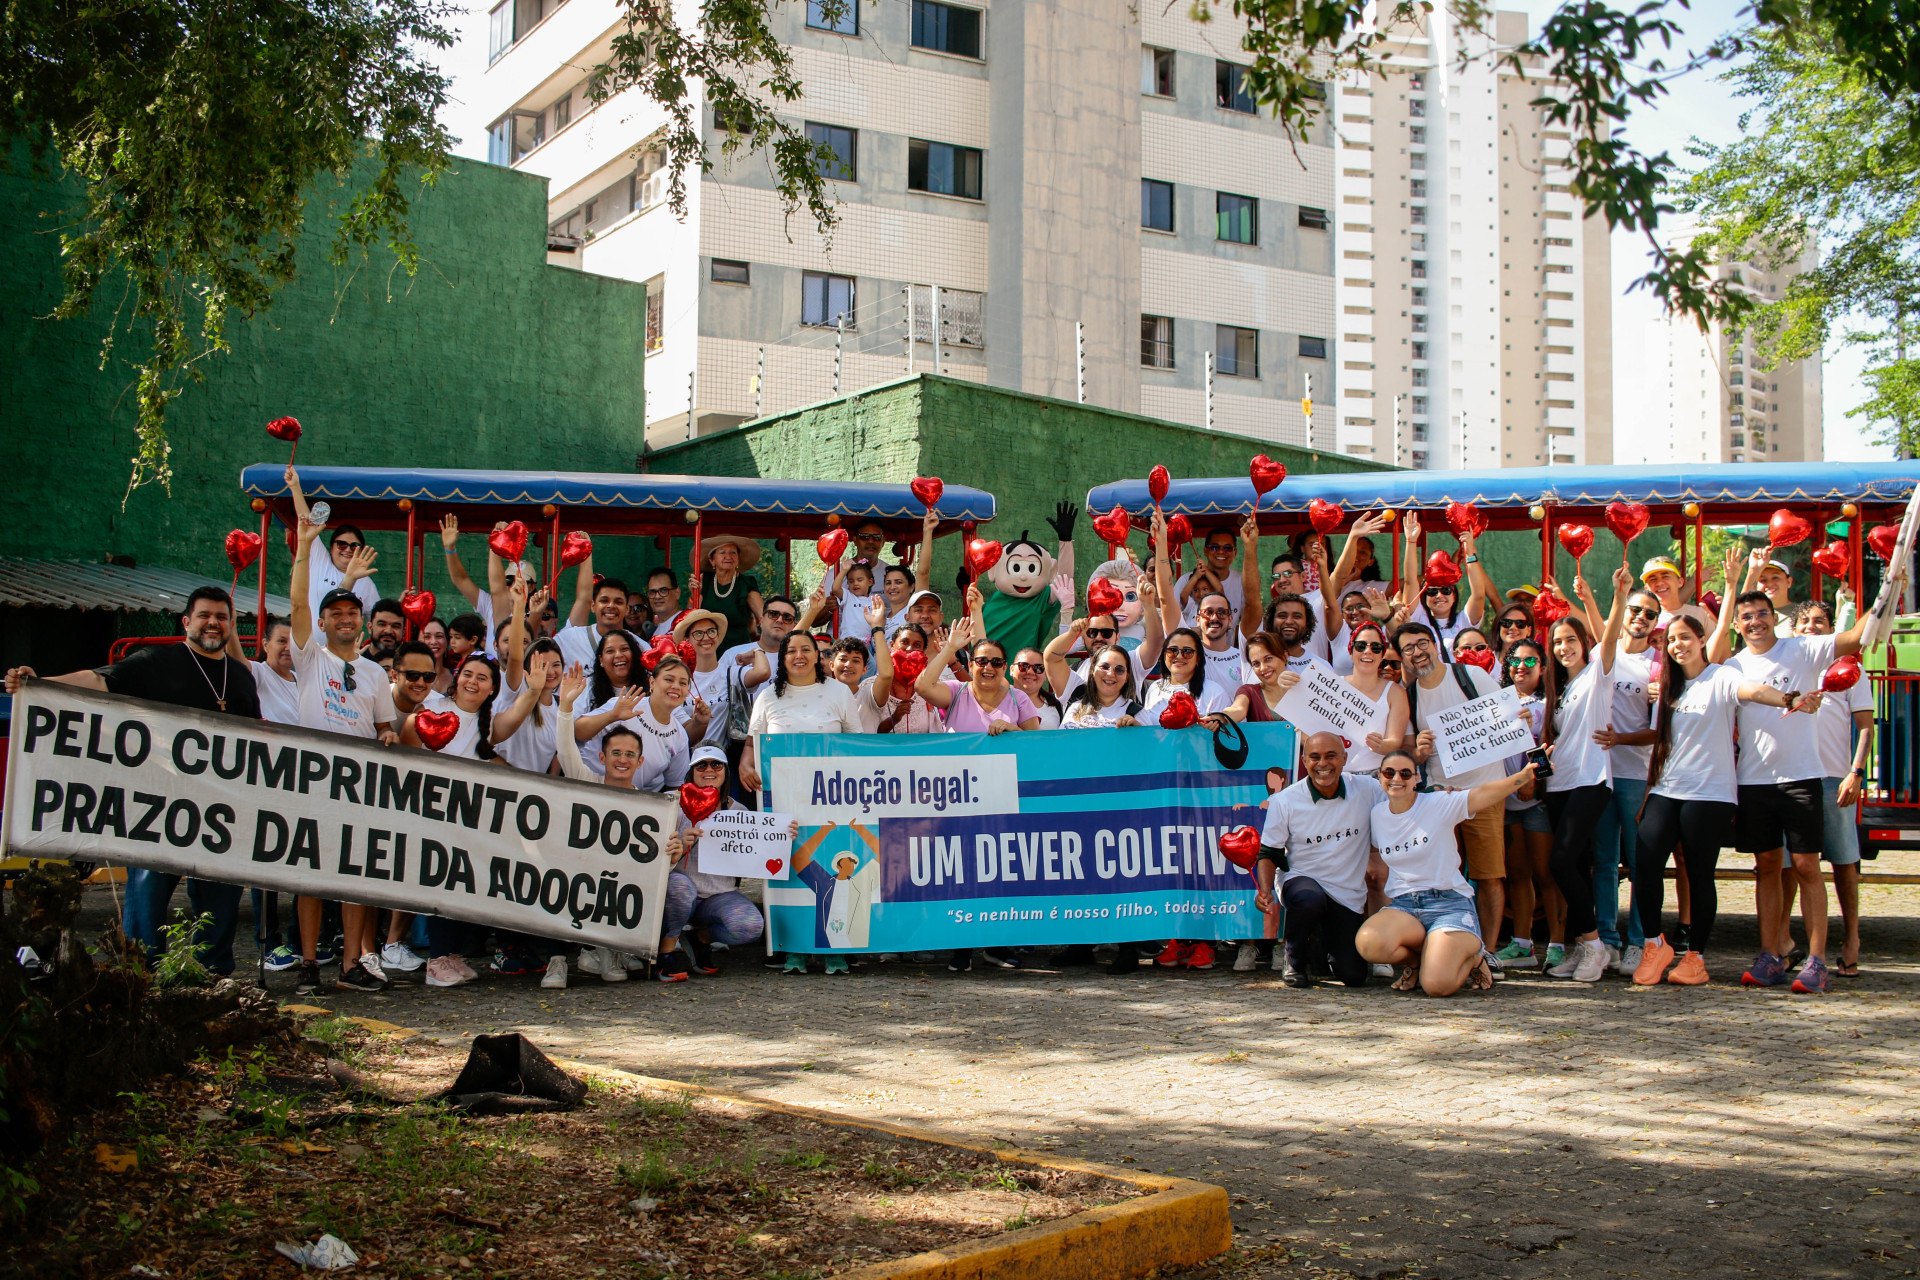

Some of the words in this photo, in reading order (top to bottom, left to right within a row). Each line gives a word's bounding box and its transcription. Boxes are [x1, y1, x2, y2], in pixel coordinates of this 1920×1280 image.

[1307, 681, 1342, 709] merece
[1343, 707, 1366, 726] uma
[1316, 673, 1340, 692] toda
[1341, 690, 1375, 717] criança
[1308, 698, 1346, 729] família
[1439, 711, 1462, 725] Não
[1444, 714, 1489, 736] acolher.
[1448, 728, 1487, 752] preciso
[1452, 746, 1477, 761] culo
[1480, 742, 1486, 751] e
[1488, 728, 1528, 747] futuro.
[24, 705, 151, 768] PELO
[171, 729, 550, 841] CUMPRIMENTO
[567, 802, 660, 864] DOS
[811, 770, 902, 813] Adoção
[909, 769, 979, 811] legal:
[710, 828, 759, 840] constrói
[763, 831, 787, 841] com
[712, 812, 756, 825] família
[762, 816, 775, 826] se
[31, 779, 236, 854] PRAZOS
[252, 809, 321, 870] DA
[338, 823, 407, 882] LEI
[419, 838, 476, 894] DA
[487, 856, 643, 930] ADOÇÃO
[721, 840, 757, 854] afeto.
[909, 835, 965, 887] UM
[975, 831, 1085, 883] DEVER
[979, 907, 1044, 922] nenhum
[1050, 906, 1058, 919] é
[1064, 907, 1111, 920] nosso
[1115, 902, 1159, 919] filho,
[1165, 900, 1205, 915] todos
